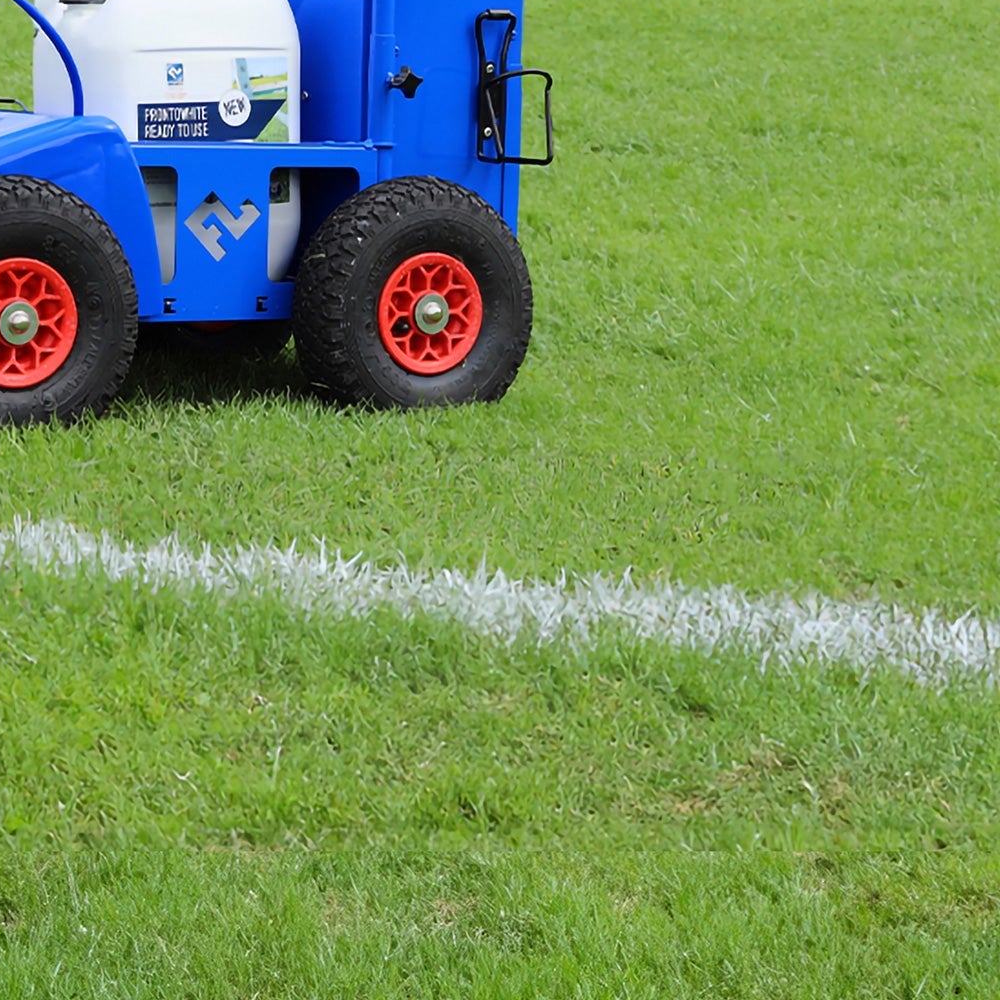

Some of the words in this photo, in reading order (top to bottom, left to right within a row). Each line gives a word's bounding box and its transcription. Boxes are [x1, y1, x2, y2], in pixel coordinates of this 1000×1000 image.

[144, 105, 208, 122] PRONTOWHITE
[223, 97, 245, 117] NEW
[144, 124, 175, 139] READY
[178, 123, 190, 138] TO
[191, 122, 209, 138] USE
